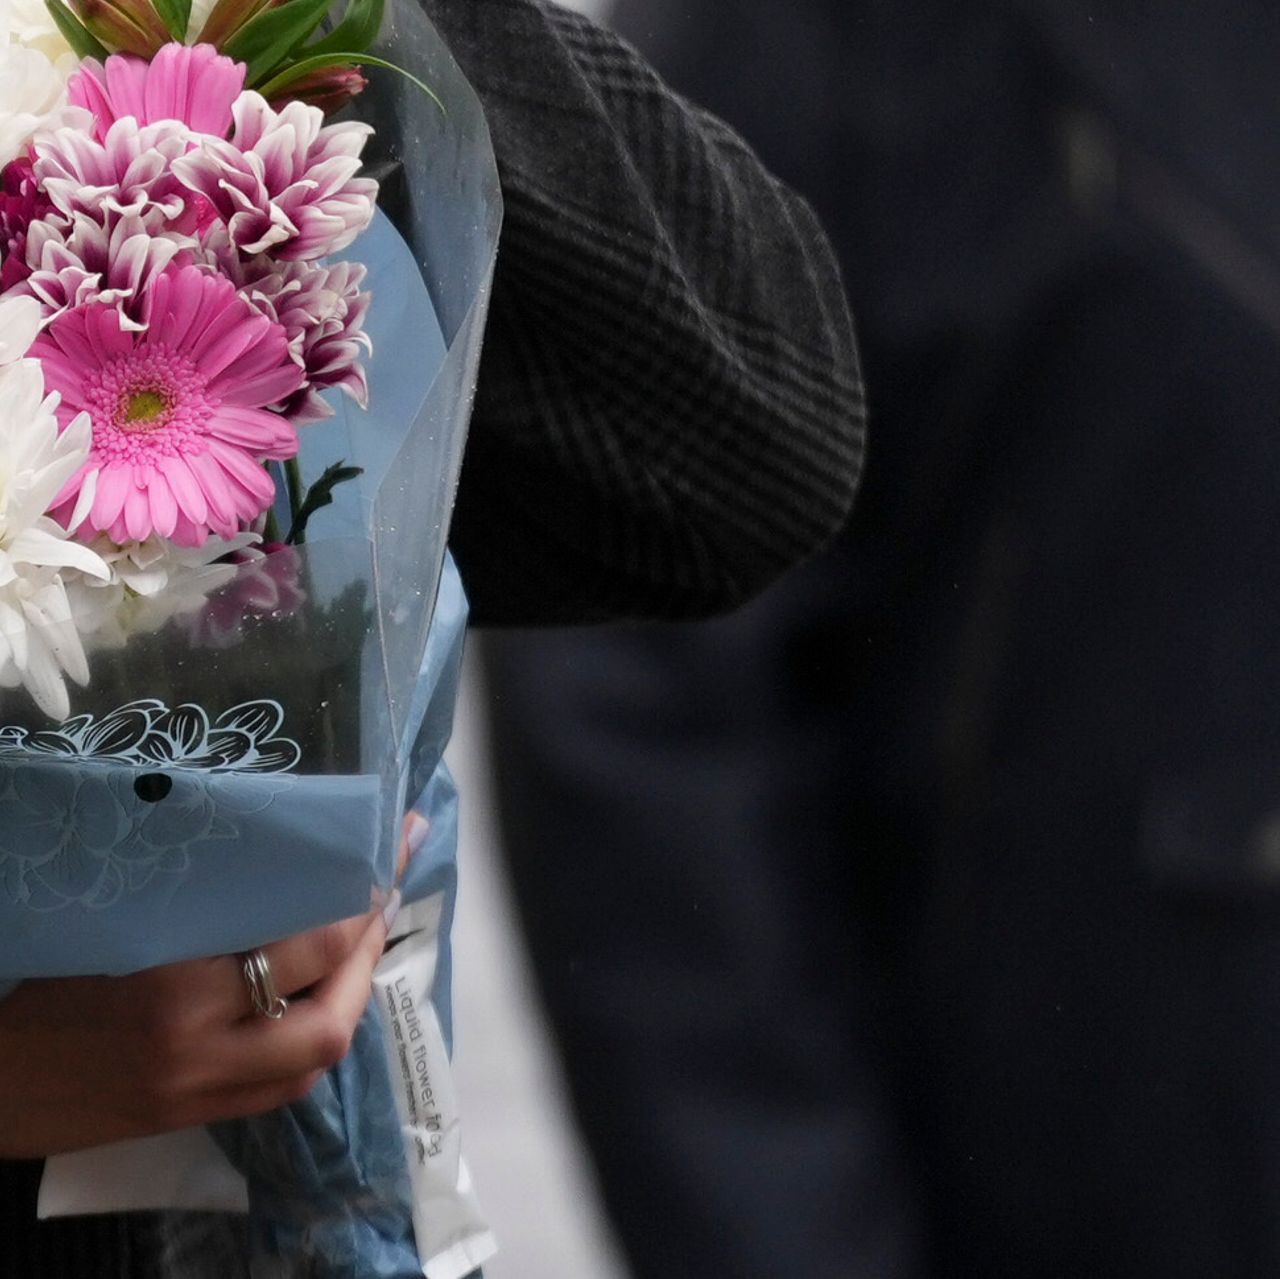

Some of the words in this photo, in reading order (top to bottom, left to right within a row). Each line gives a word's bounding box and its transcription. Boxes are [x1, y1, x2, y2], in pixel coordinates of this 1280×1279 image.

[395, 976, 422, 1041] Liquid
[414, 1045, 436, 1107] flower
[425, 1113, 442, 1157] food
